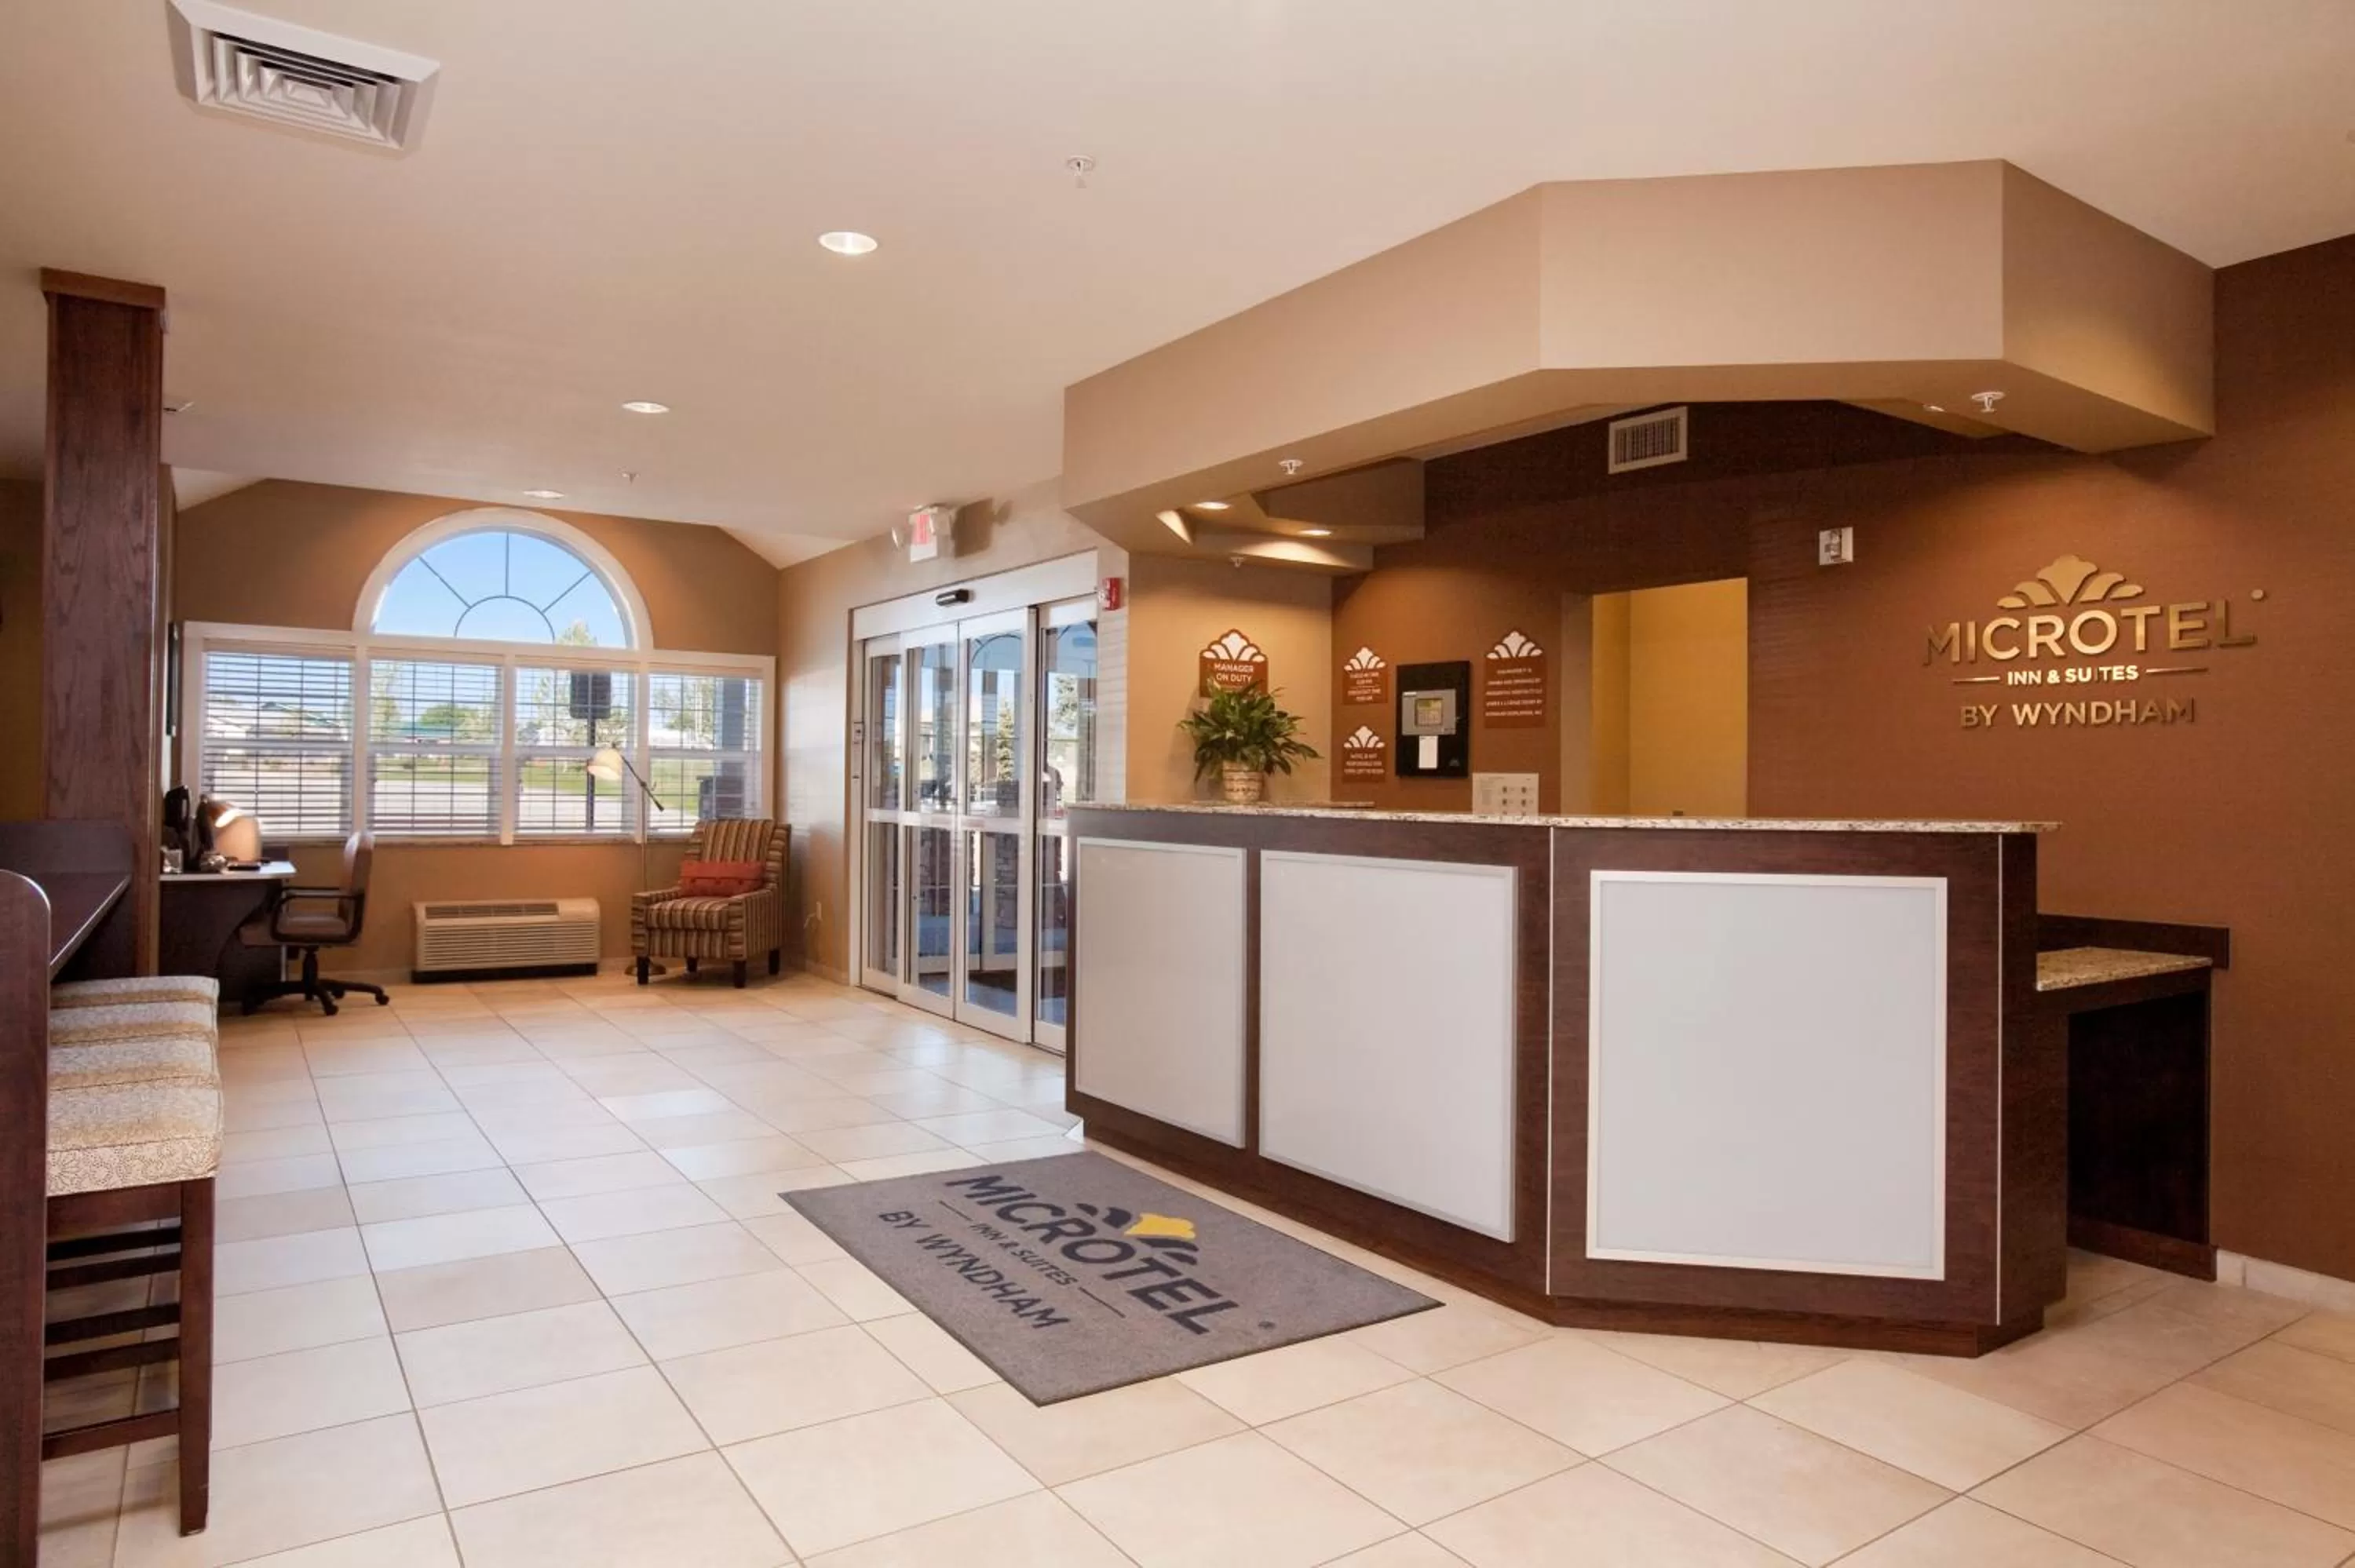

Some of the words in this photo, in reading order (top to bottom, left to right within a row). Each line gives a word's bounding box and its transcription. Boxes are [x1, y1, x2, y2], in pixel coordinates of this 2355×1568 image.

[1923, 599, 2258, 665] MICROTEL
[1214, 662, 1254, 673] MANAGER
[1216, 673, 1229, 681] ON
[1230, 673, 1252, 684] DUTY
[2006, 669, 2042, 686] INN
[2046, 669, 2061, 684] &
[2065, 665, 2139, 685] SUITES
[1962, 704, 1999, 727] BY
[2011, 697, 2195, 727] WYNDHAM
[878, 1211, 930, 1230] BY
[915, 1233, 1071, 1329] WYNDHAM
[945, 1175, 1239, 1335] MICROTEL
[970, 1223, 1002, 1242] INN
[998, 1240, 1012, 1250] &
[1010, 1245, 1078, 1287] SUITES
